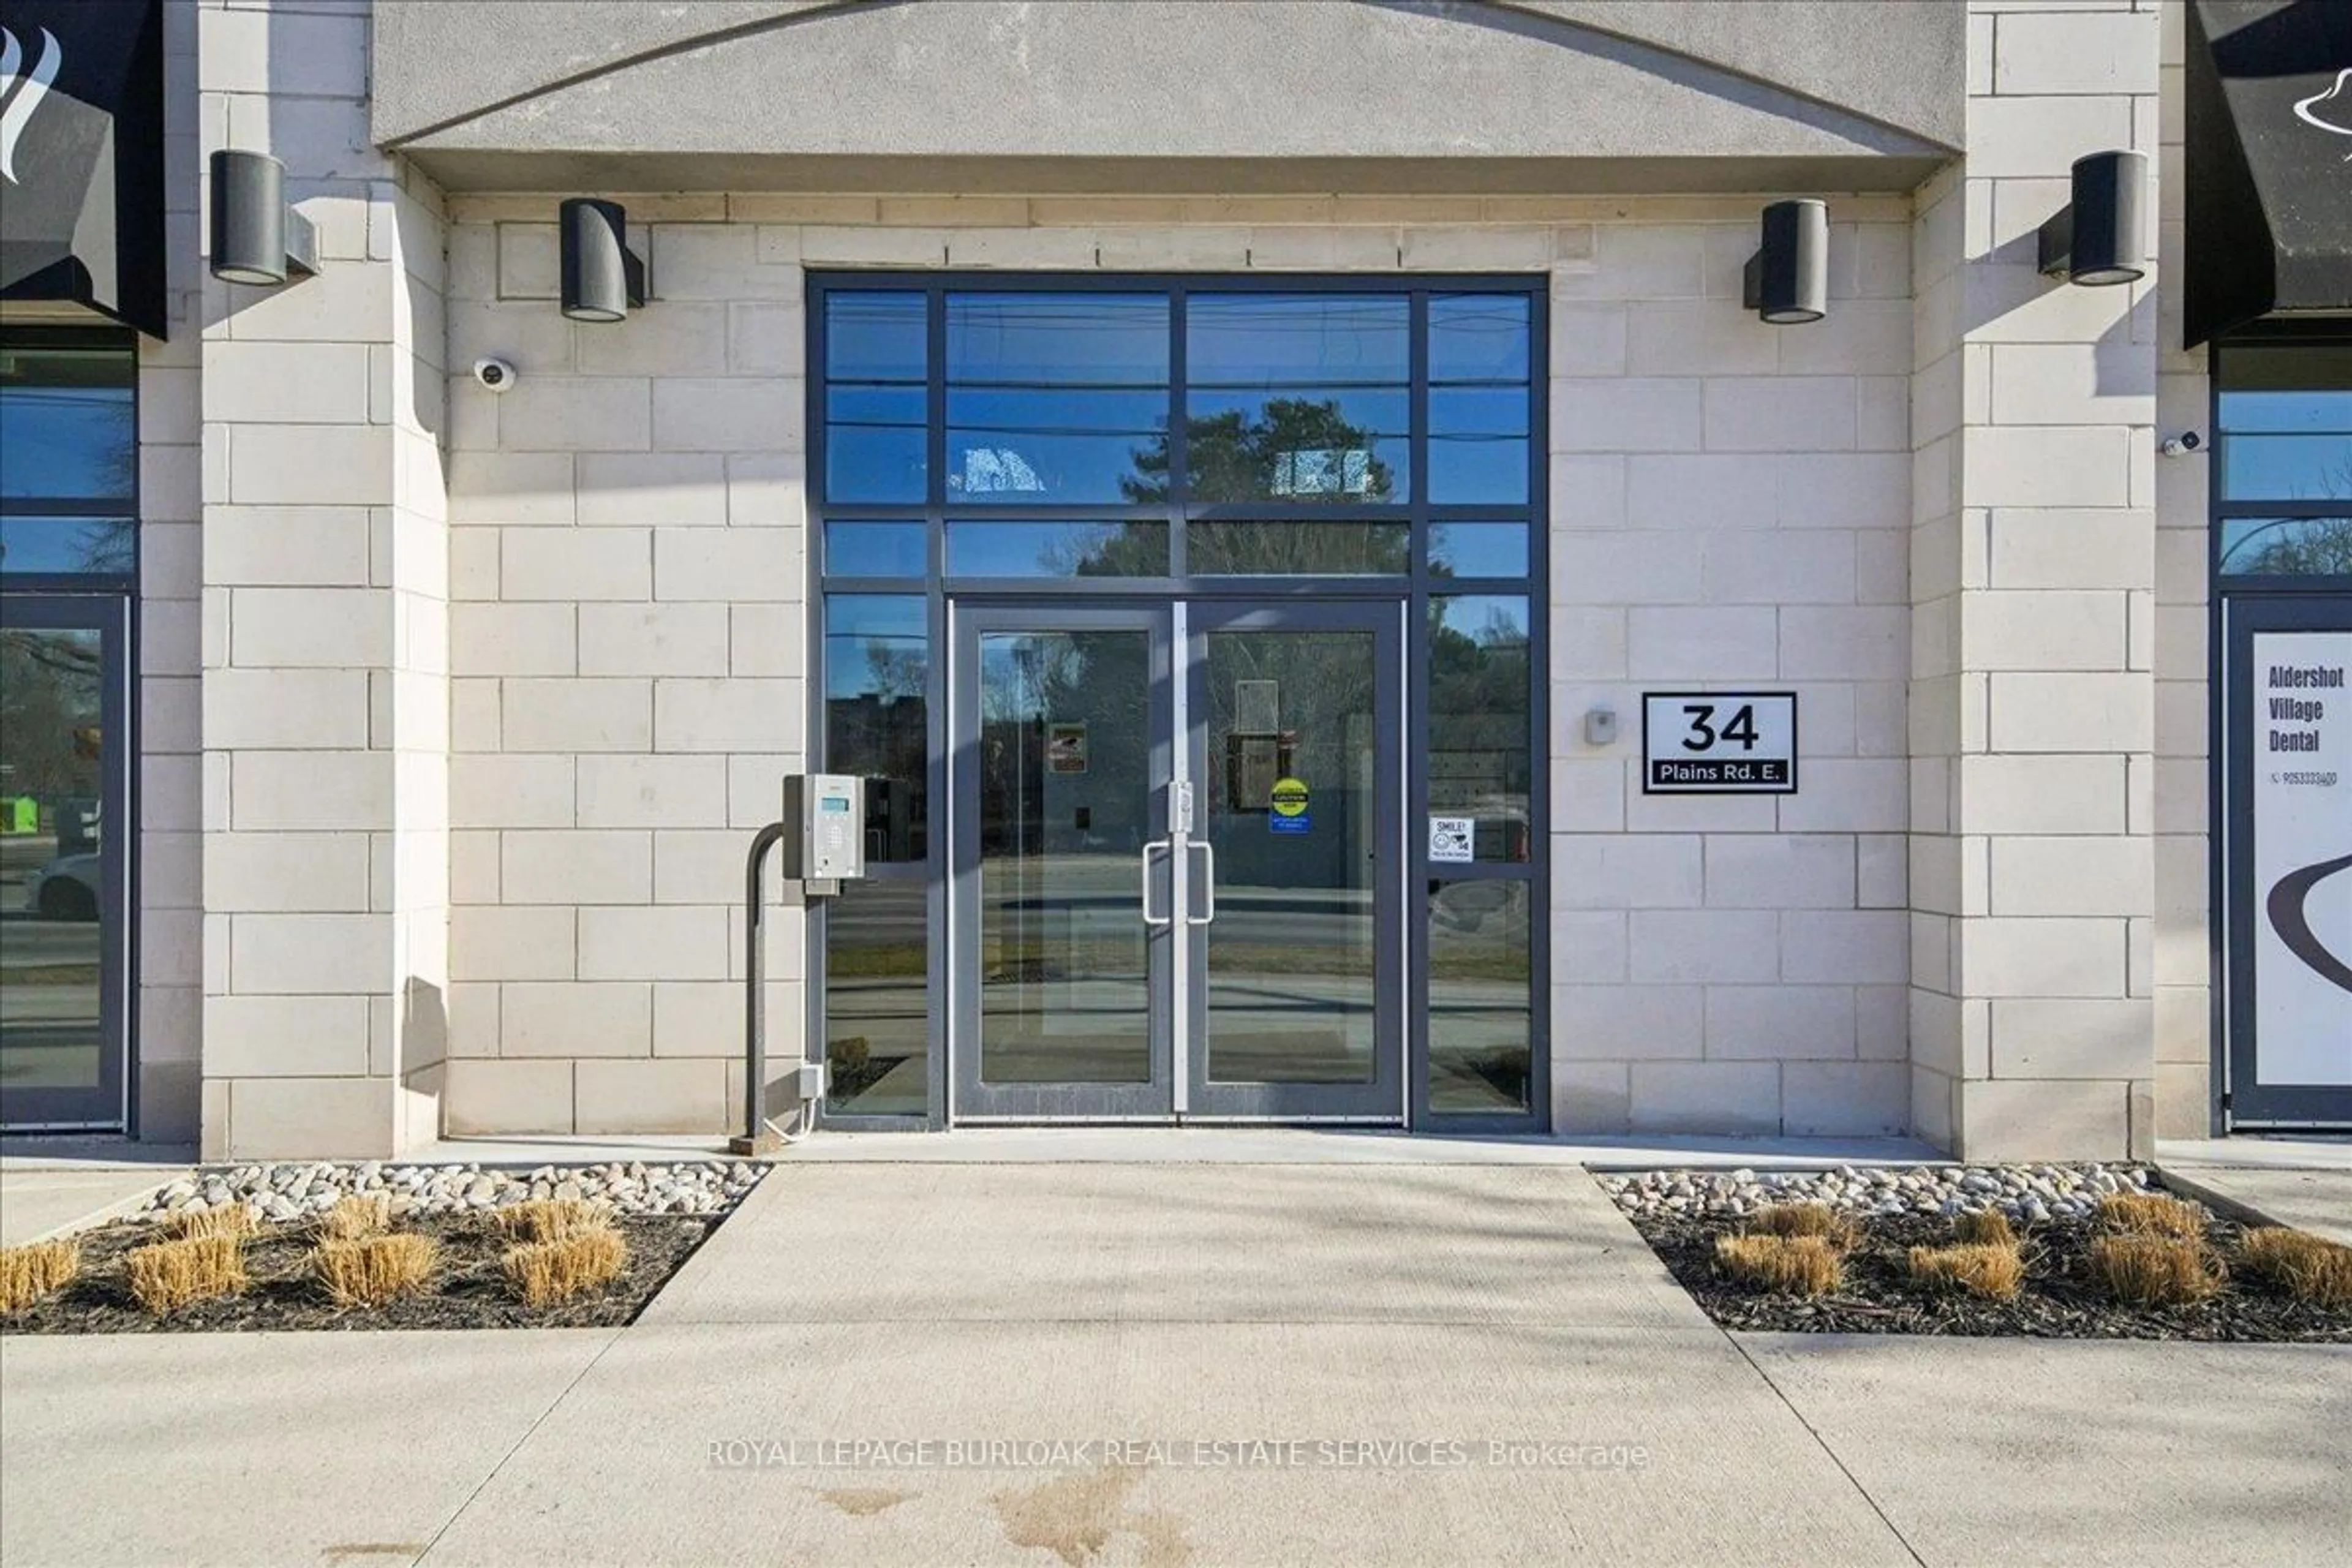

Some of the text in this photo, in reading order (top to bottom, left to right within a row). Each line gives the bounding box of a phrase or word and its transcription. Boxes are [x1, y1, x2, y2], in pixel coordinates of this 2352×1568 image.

[2269, 666, 2344, 688] Aldershot
[2269, 697, 2323, 723] Village
[1682, 705, 1759, 751] 34
[2269, 729, 2319, 752] Dental
[1660, 764, 1779, 780] Plains Rd. E.
